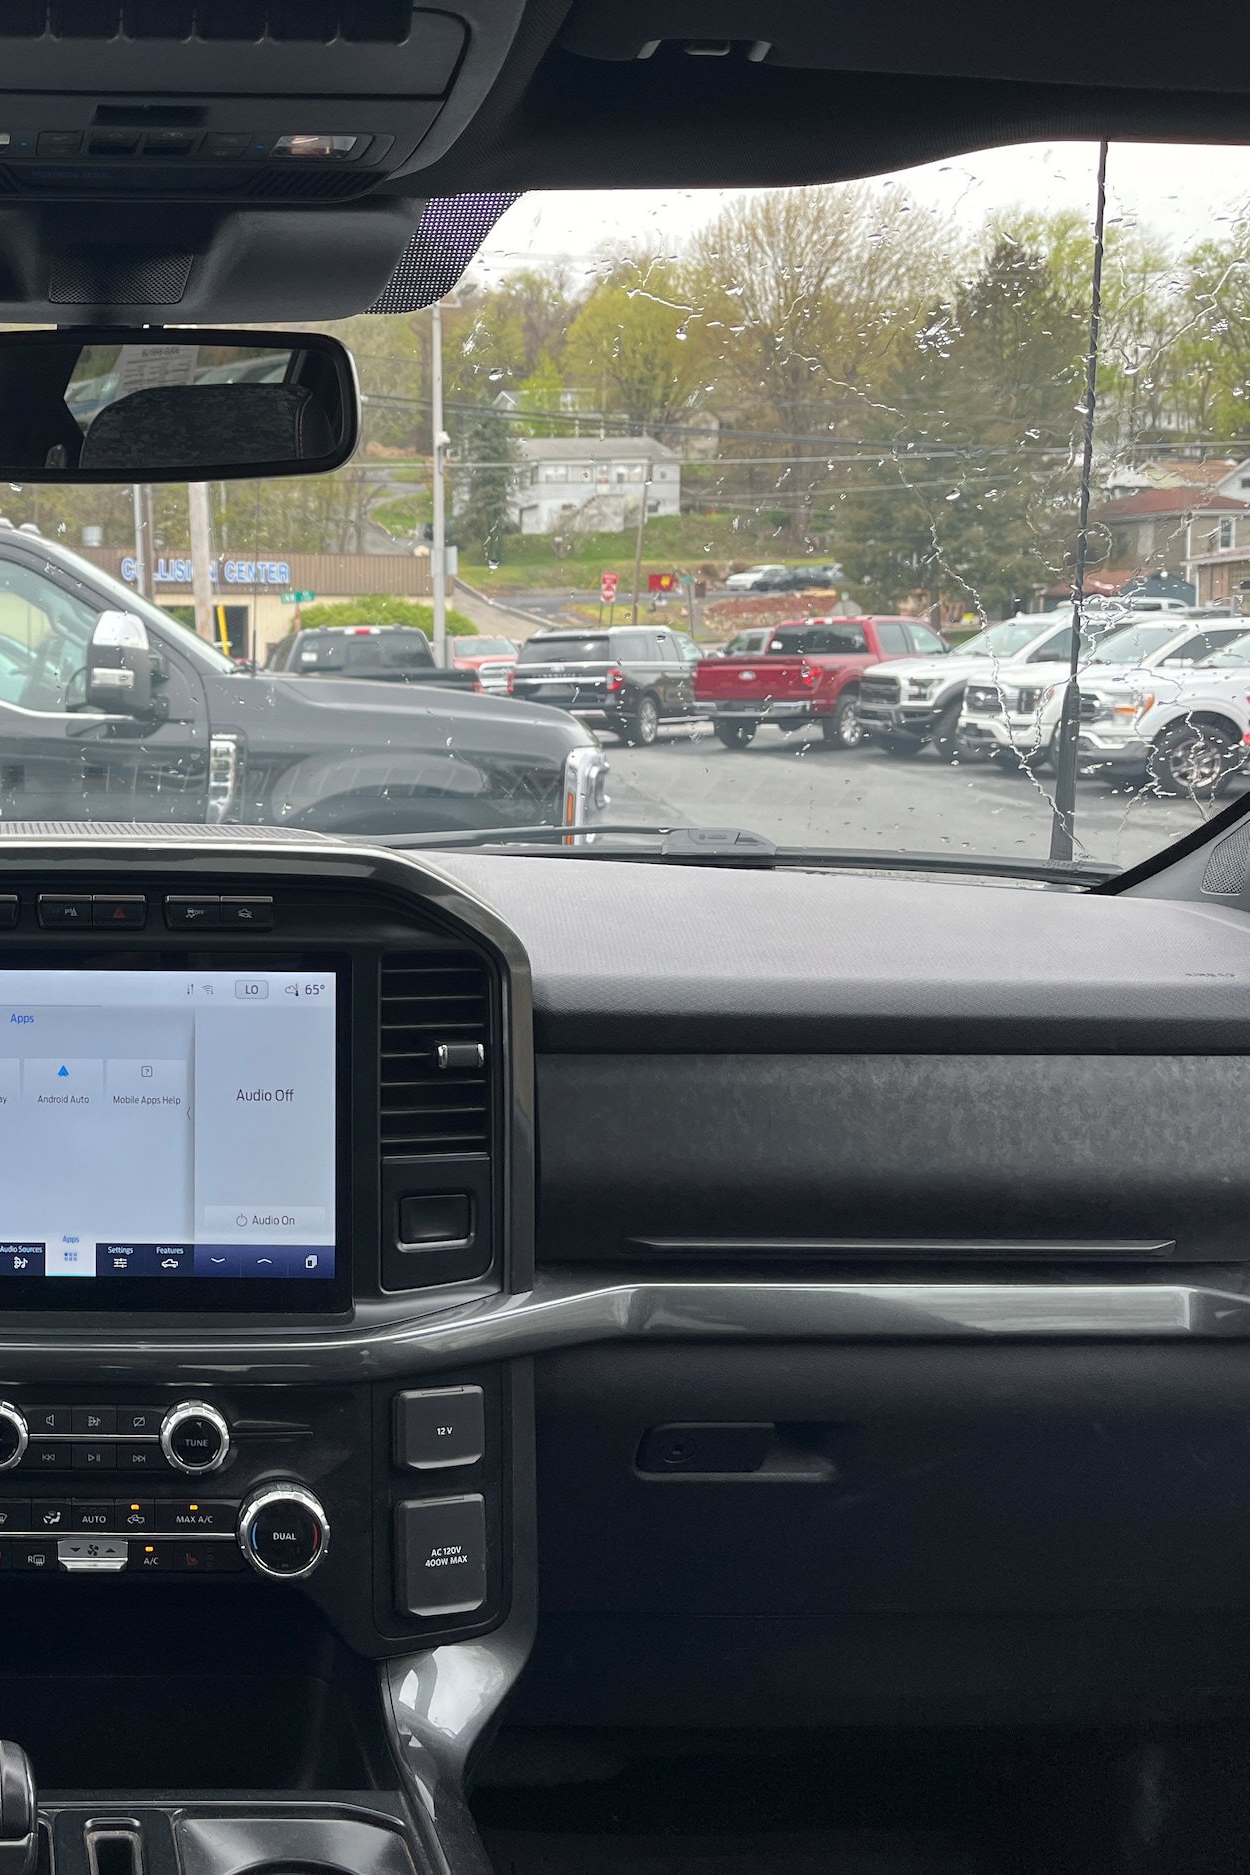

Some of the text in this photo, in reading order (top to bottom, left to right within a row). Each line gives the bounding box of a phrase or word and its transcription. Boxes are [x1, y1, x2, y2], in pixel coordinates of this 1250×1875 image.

[121, 557, 290, 584] CLISIN CENTER
[245, 985, 259, 995] LO
[305, 984, 325, 995] 65°
[10, 1013, 34, 1024] Apps
[38, 1095, 90, 1104] Android Auto
[236, 1089, 294, 1101] Audio Off
[113, 1096, 181, 1105] Mobile Apps Help
[252, 1215, 295, 1226] Audio On
[62, 1235, 79, 1244] Apps
[18, 1246, 43, 1254] Sources
[108, 1246, 134, 1255] Settings
[156, 1246, 184, 1254] Features
[436, 1427, 453, 1435] 12 V
[185, 1439, 208, 1447] TUNE
[82, 1515, 107, 1524] AUTO
[176, 1515, 214, 1524] MAX A/C
[272, 1532, 297, 1540] DUAL
[431, 1546, 462, 1556] AC 120V
[143, 1557, 159, 1566] A/C
[425, 1556, 468, 1567] 400W MAX
